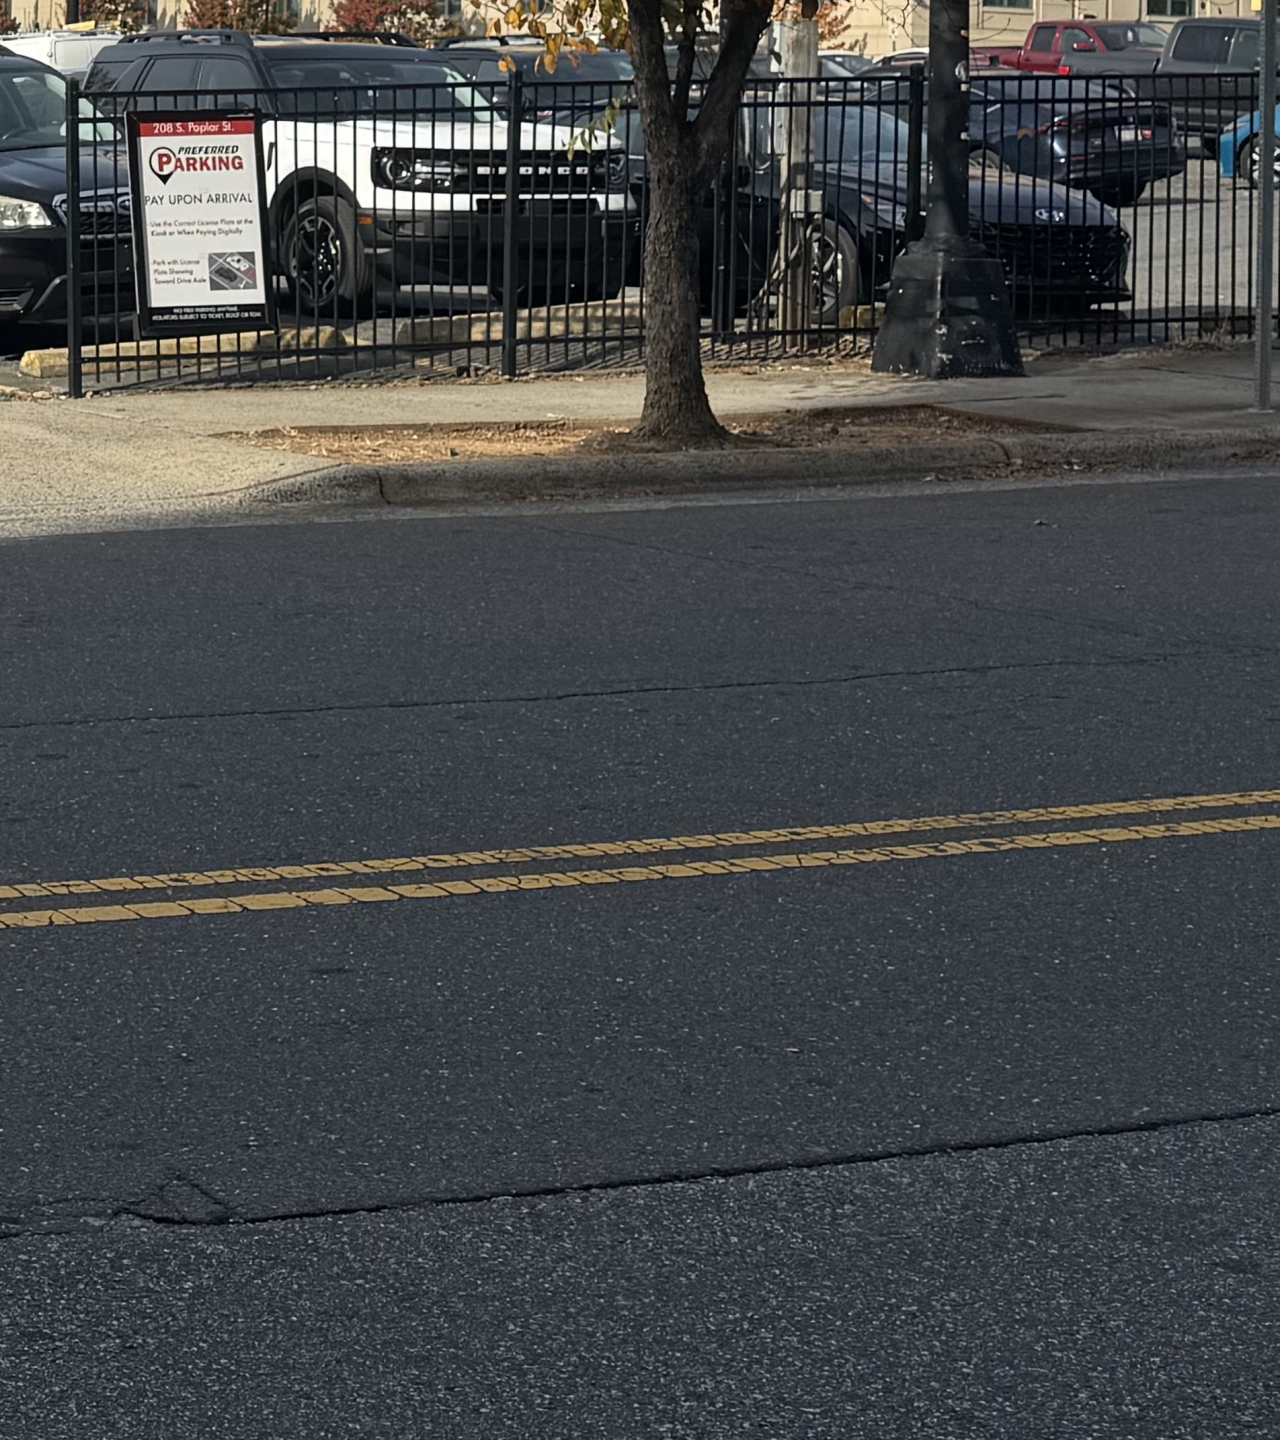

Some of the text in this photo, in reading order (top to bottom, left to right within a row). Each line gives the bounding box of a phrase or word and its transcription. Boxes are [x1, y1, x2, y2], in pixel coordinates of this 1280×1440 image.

[153, 121, 234, 134] 208 S. Poplar St.
[178, 145, 239, 155] PREFERRED
[157, 153, 244, 172] PARKING
[477, 166, 589, 175] BRONCO
[144, 193, 253, 205] PAY UPON ARRIVAL
